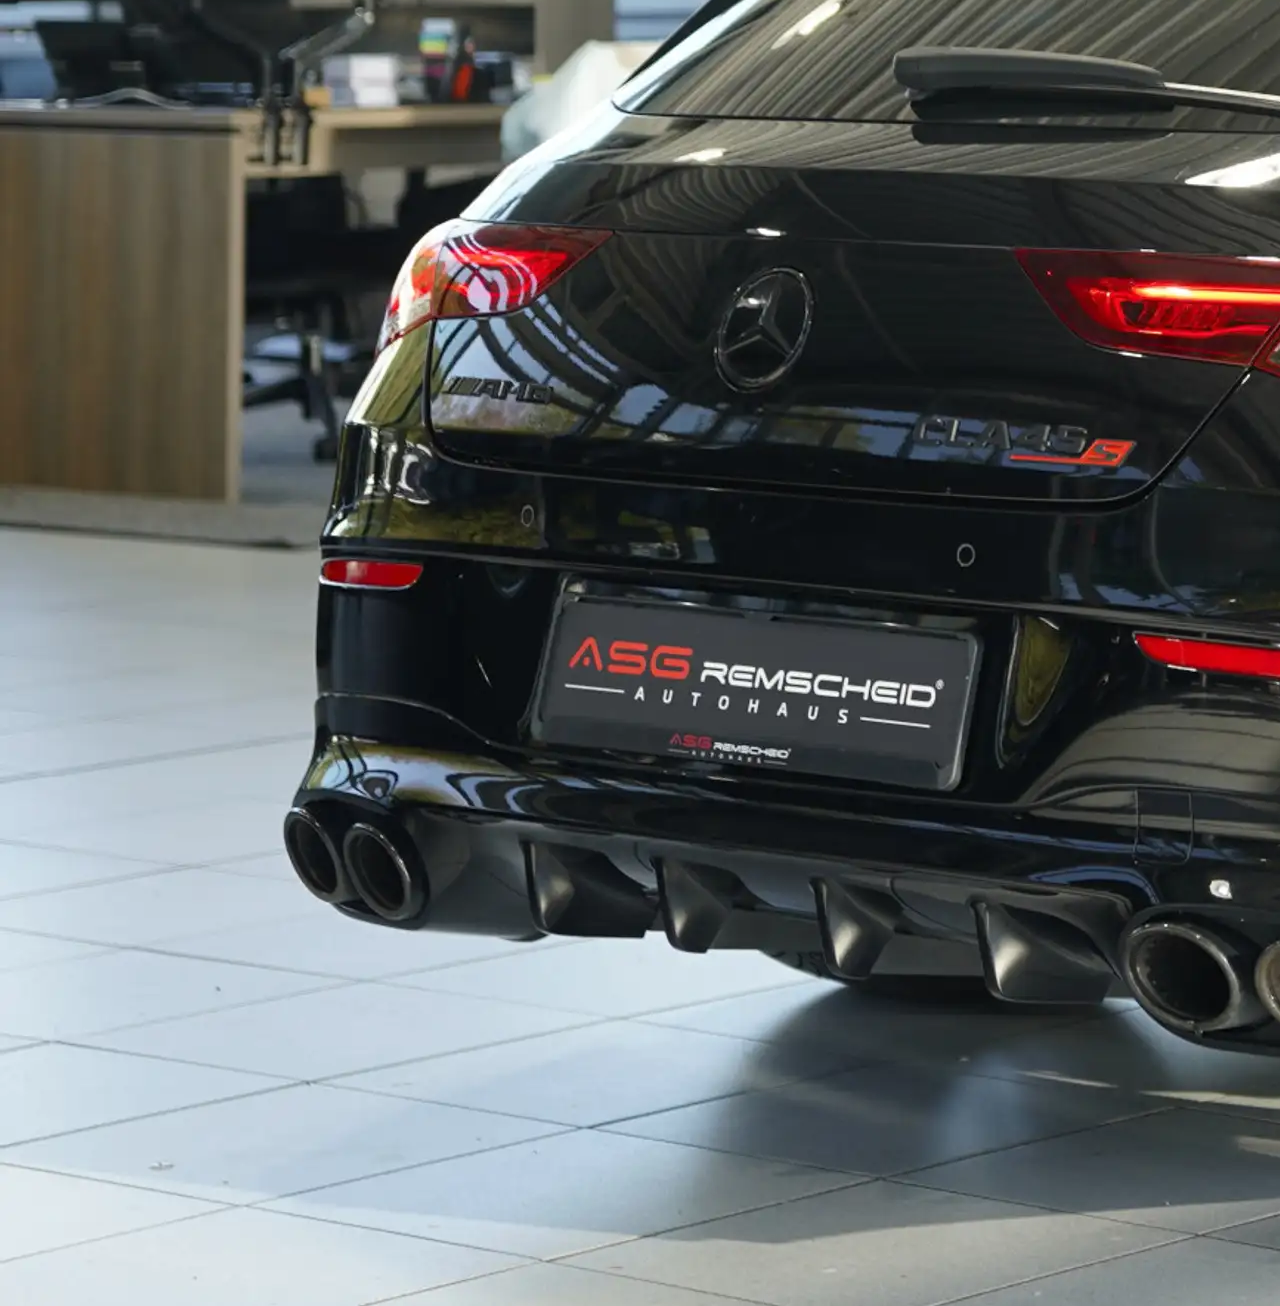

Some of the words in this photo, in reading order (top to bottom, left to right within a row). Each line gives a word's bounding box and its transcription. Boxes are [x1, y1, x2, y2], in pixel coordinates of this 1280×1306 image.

[476, 378, 555, 405] AMG
[568, 636, 694, 680] ASG
[633, 685, 849, 724] AUTOHAUS
[669, 733, 712, 750] ASG
